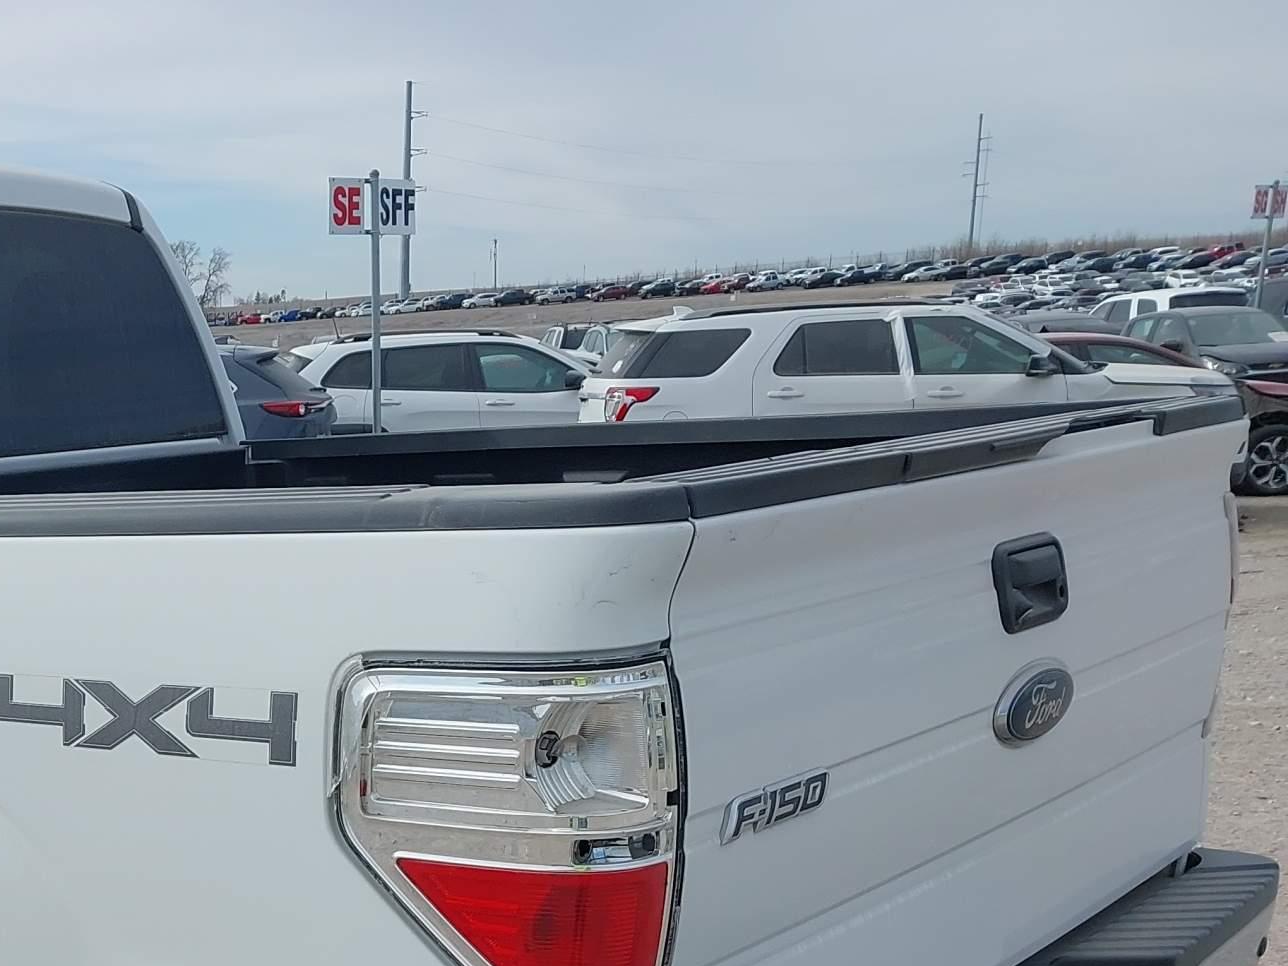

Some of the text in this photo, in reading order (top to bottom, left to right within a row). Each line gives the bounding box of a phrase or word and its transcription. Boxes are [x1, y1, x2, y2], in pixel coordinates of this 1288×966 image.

[332, 185, 361, 226] SE
[379, 186, 415, 226] SFF
[1025, 680, 1066, 729] Ford
[730, 770, 829, 839] F-150
